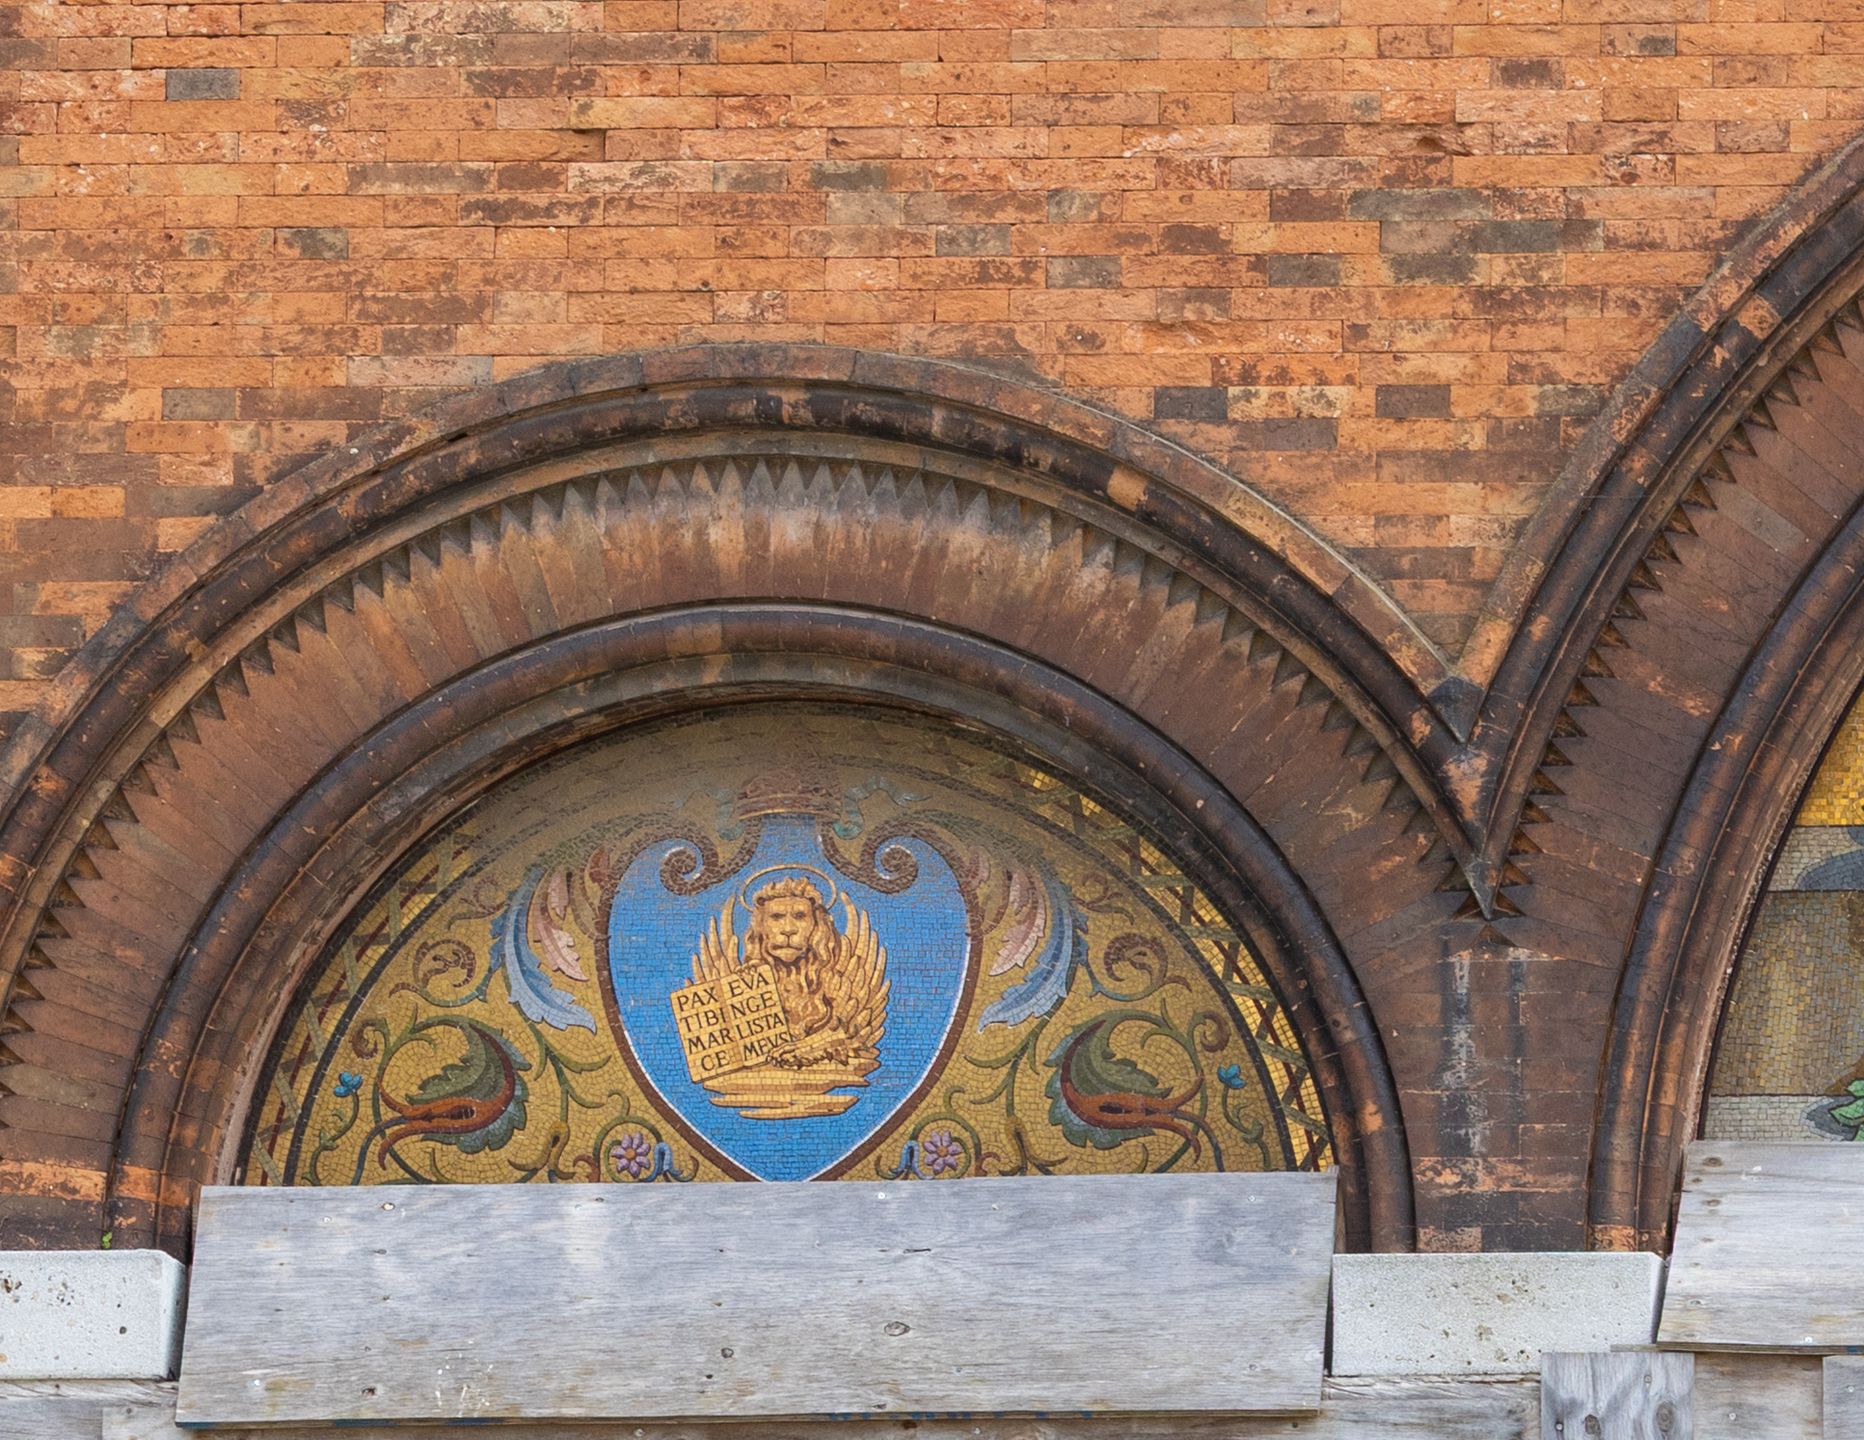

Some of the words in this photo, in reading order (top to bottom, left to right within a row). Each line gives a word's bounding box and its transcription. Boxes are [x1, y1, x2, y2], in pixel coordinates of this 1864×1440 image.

[728, 972, 769, 998] EVA
[677, 987, 718, 1012] PAX
[680, 1007, 727, 1032] TIBI
[736, 1012, 784, 1040] LISTA
[687, 1028, 735, 1054] MAR
[701, 1050, 730, 1071] CE
